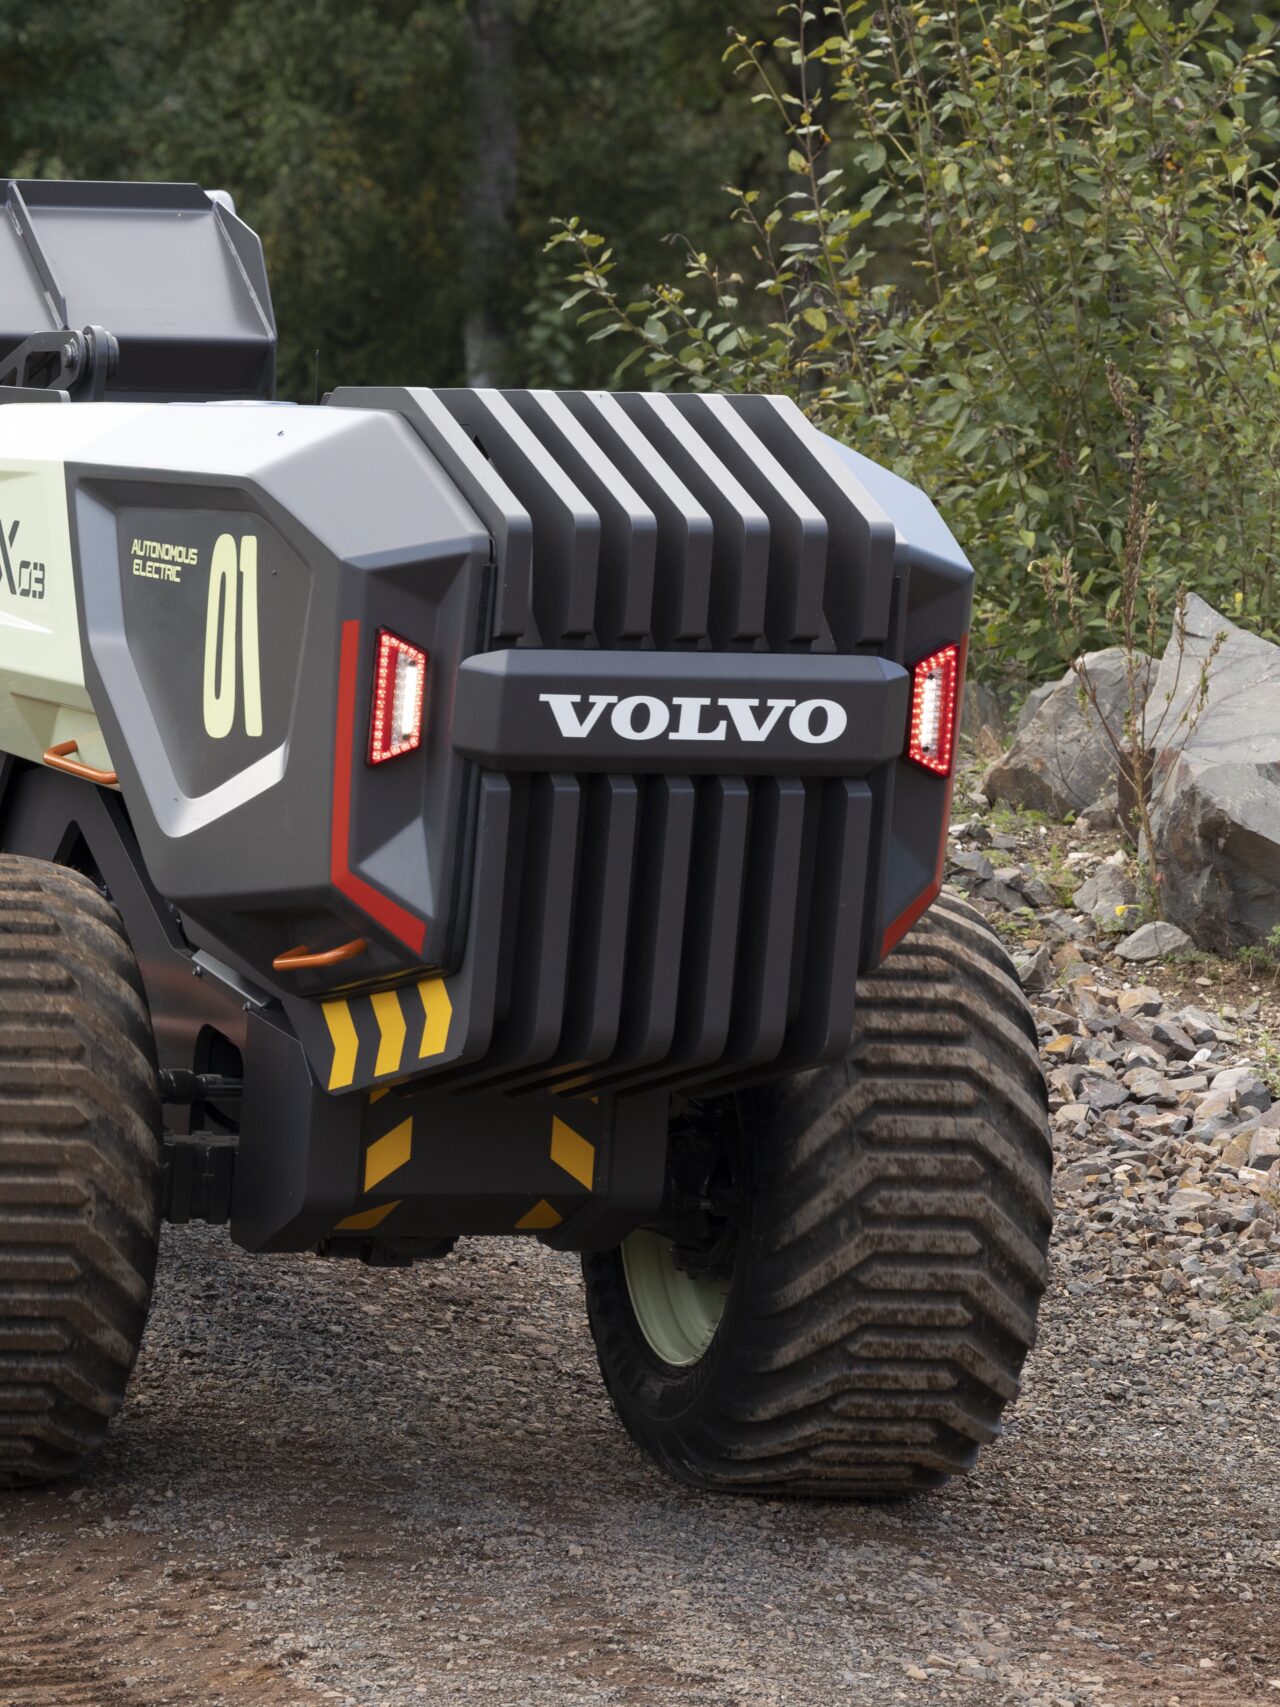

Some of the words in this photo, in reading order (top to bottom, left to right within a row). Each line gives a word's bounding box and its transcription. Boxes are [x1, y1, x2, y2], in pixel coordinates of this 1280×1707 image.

[131, 538, 198, 565] AUTONOMOUS
[132, 558, 182, 583] ELECTRIC
[203, 533, 263, 739] 01
[539, 693, 848, 744] VOLVO
